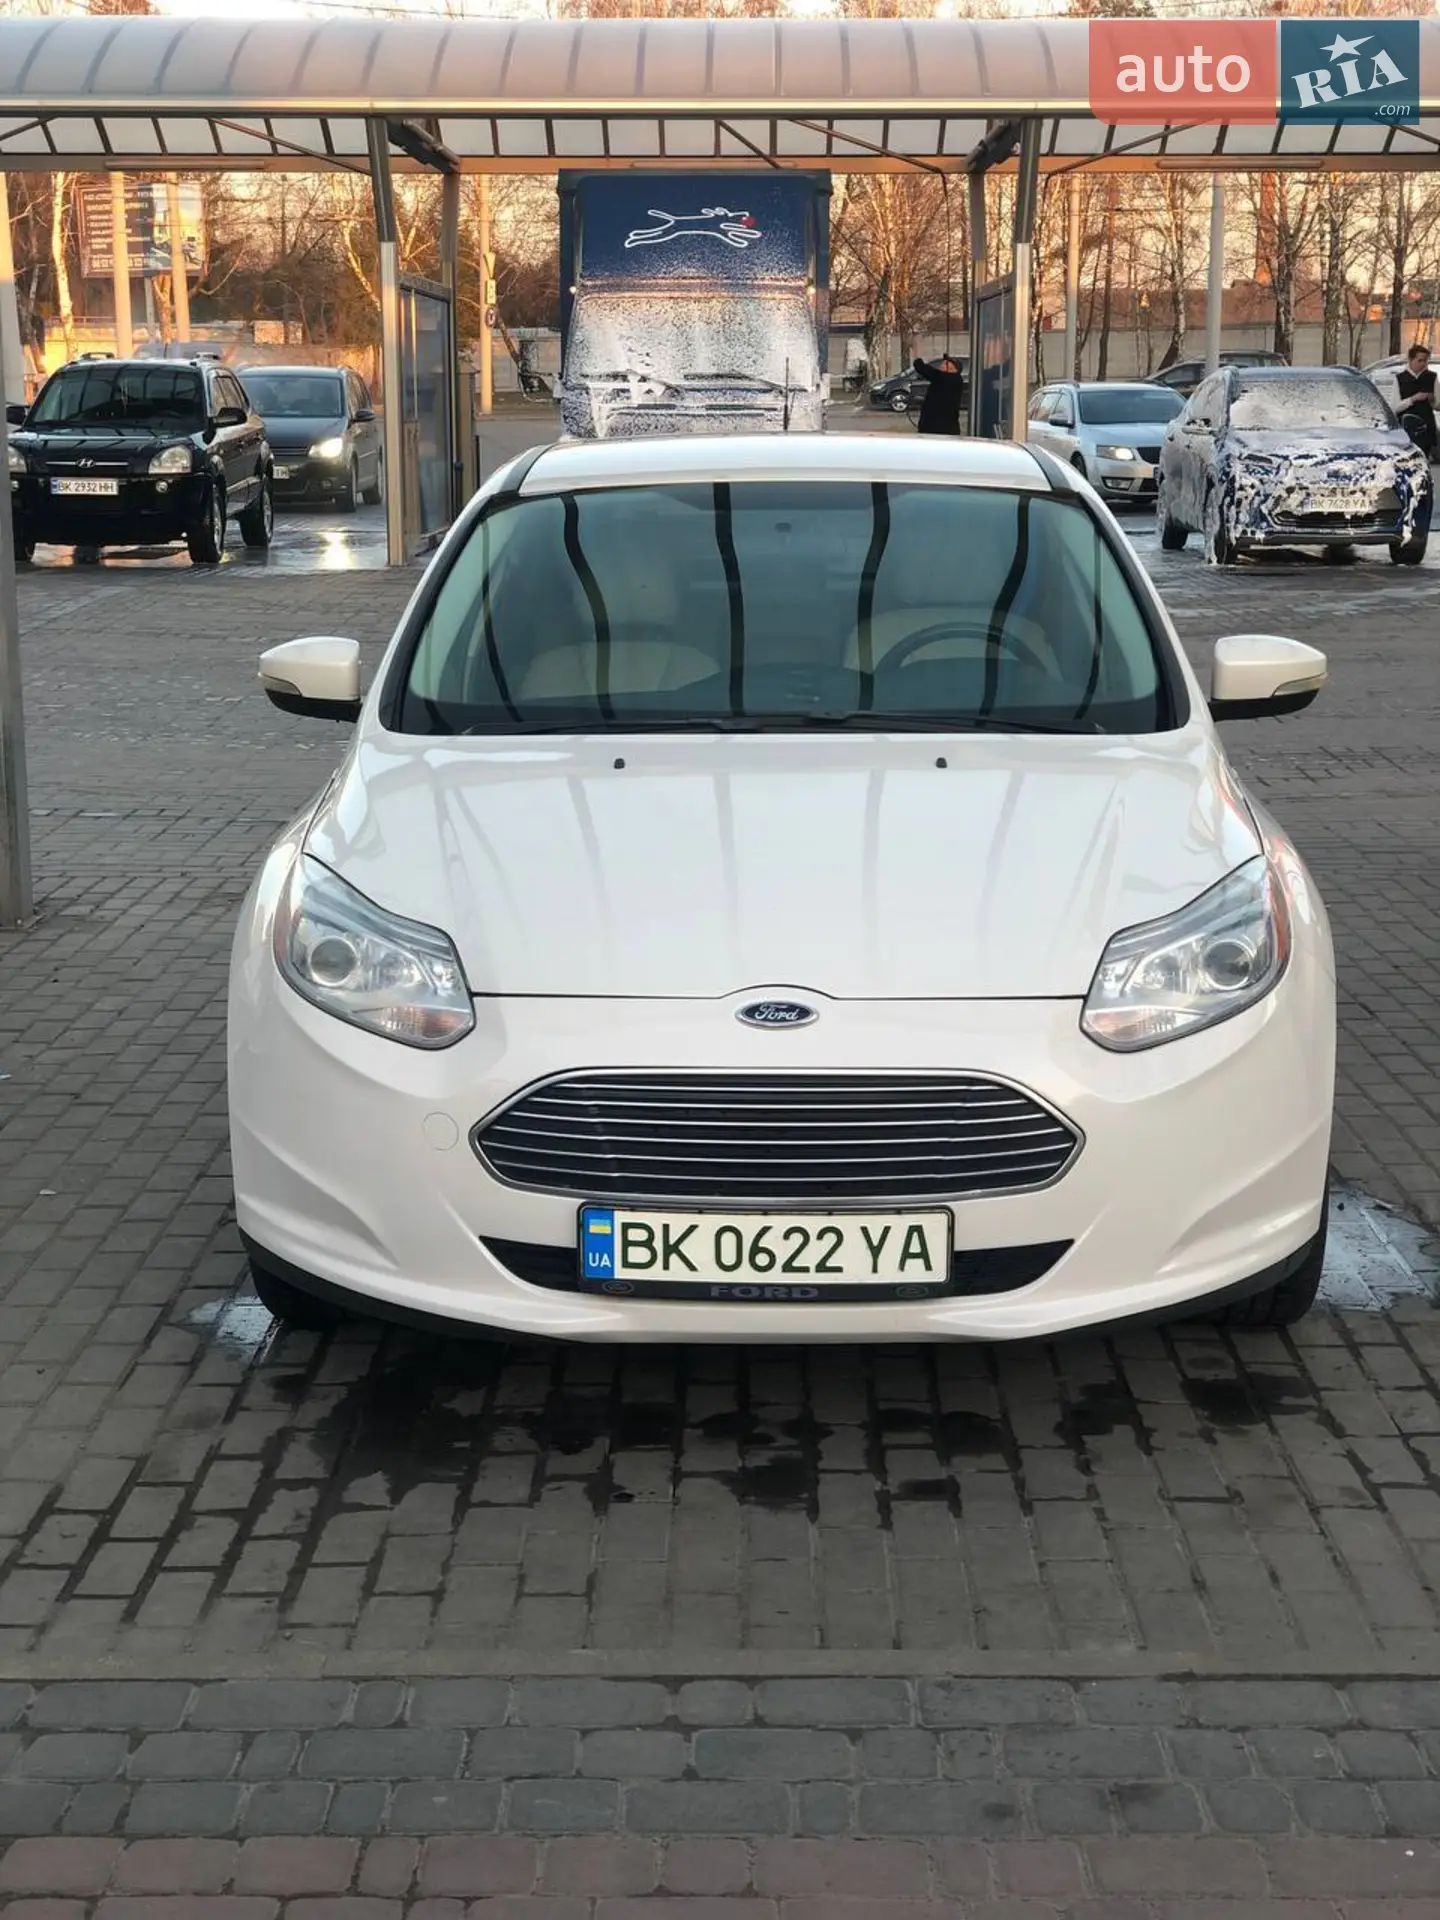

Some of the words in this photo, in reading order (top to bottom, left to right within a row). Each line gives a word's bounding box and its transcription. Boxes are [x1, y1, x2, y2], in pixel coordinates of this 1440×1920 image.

[754, 1003, 799, 1020] Ford
[621, 1222, 700, 1272] BK
[714, 1224, 844, 1274] 0622
[860, 1224, 933, 1273] YA
[589, 1252, 611, 1267] UA
[710, 1285, 819, 1299] FORD
